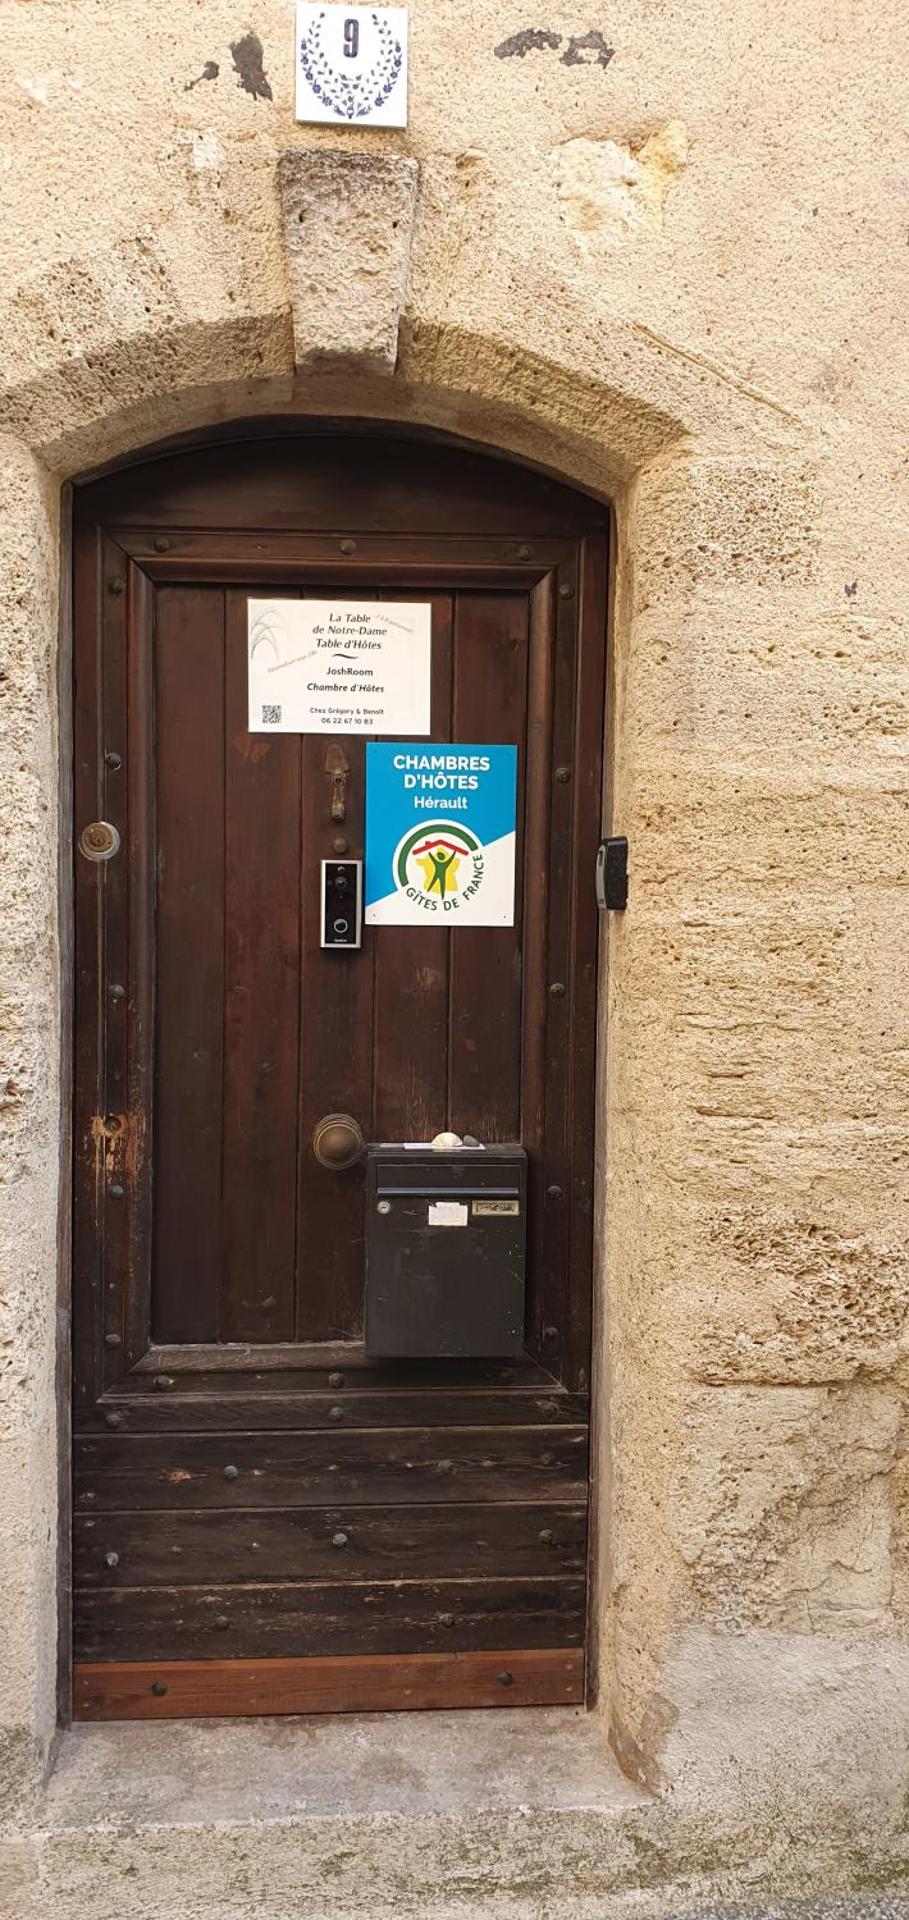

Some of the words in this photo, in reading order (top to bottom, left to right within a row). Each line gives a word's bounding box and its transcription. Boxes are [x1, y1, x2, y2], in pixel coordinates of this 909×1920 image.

[343, 18, 359, 58] 9
[329, 613, 341, 622] La
[345, 614, 371, 622] Table
[312, 625, 325, 634] de
[328, 626, 387, 635] Notre-Dame
[316, 638, 342, 648] Table
[344, 640, 382, 649] d'Hôtes
[326, 667, 374, 676] JoshRoom
[306, 683, 348, 692] Chambre
[350, 684, 384, 692] d'Hôtes
[328, 707, 354, 715] Grégory
[393, 755, 490, 771] CHAMBRES
[404, 772, 479, 790] D'HÔTES
[414, 796, 468, 809] Hérault
[406, 887, 438, 911] GÎTES
[443, 898, 460, 911] DE
[462, 854, 484, 901] FRANCE
